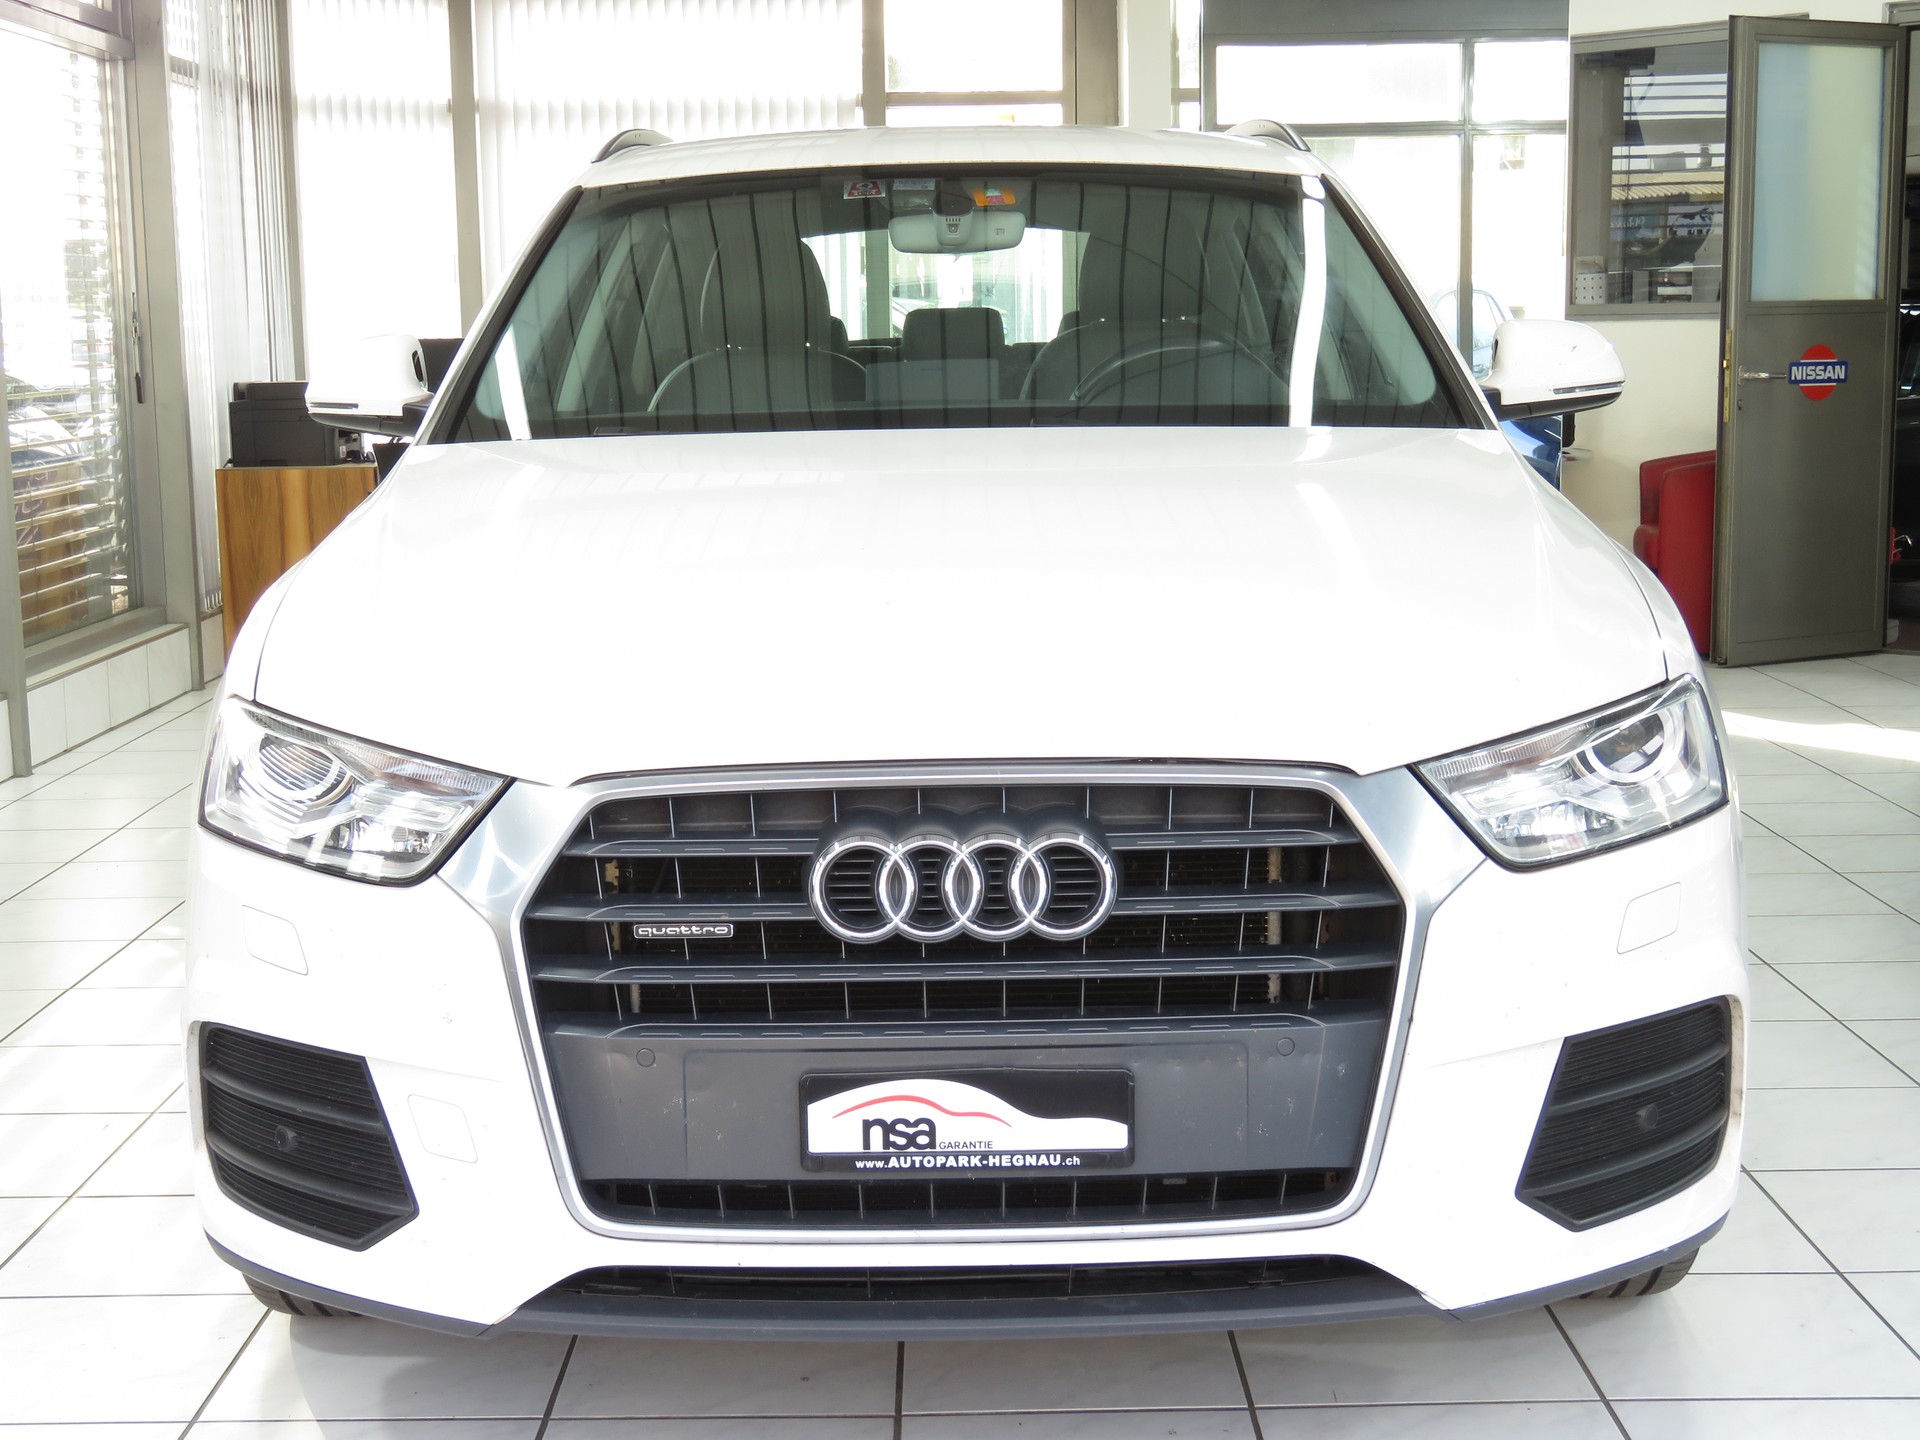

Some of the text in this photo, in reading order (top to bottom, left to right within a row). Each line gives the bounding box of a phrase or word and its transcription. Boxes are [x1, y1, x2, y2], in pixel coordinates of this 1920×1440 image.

[1791, 365, 1845, 381] NISSAN
[638, 925, 729, 937] quattro
[862, 1117, 993, 1151] nsa GARANTIE
[855, 1154, 1081, 1168] www.AUTOPARK-HEGNAU.ch
